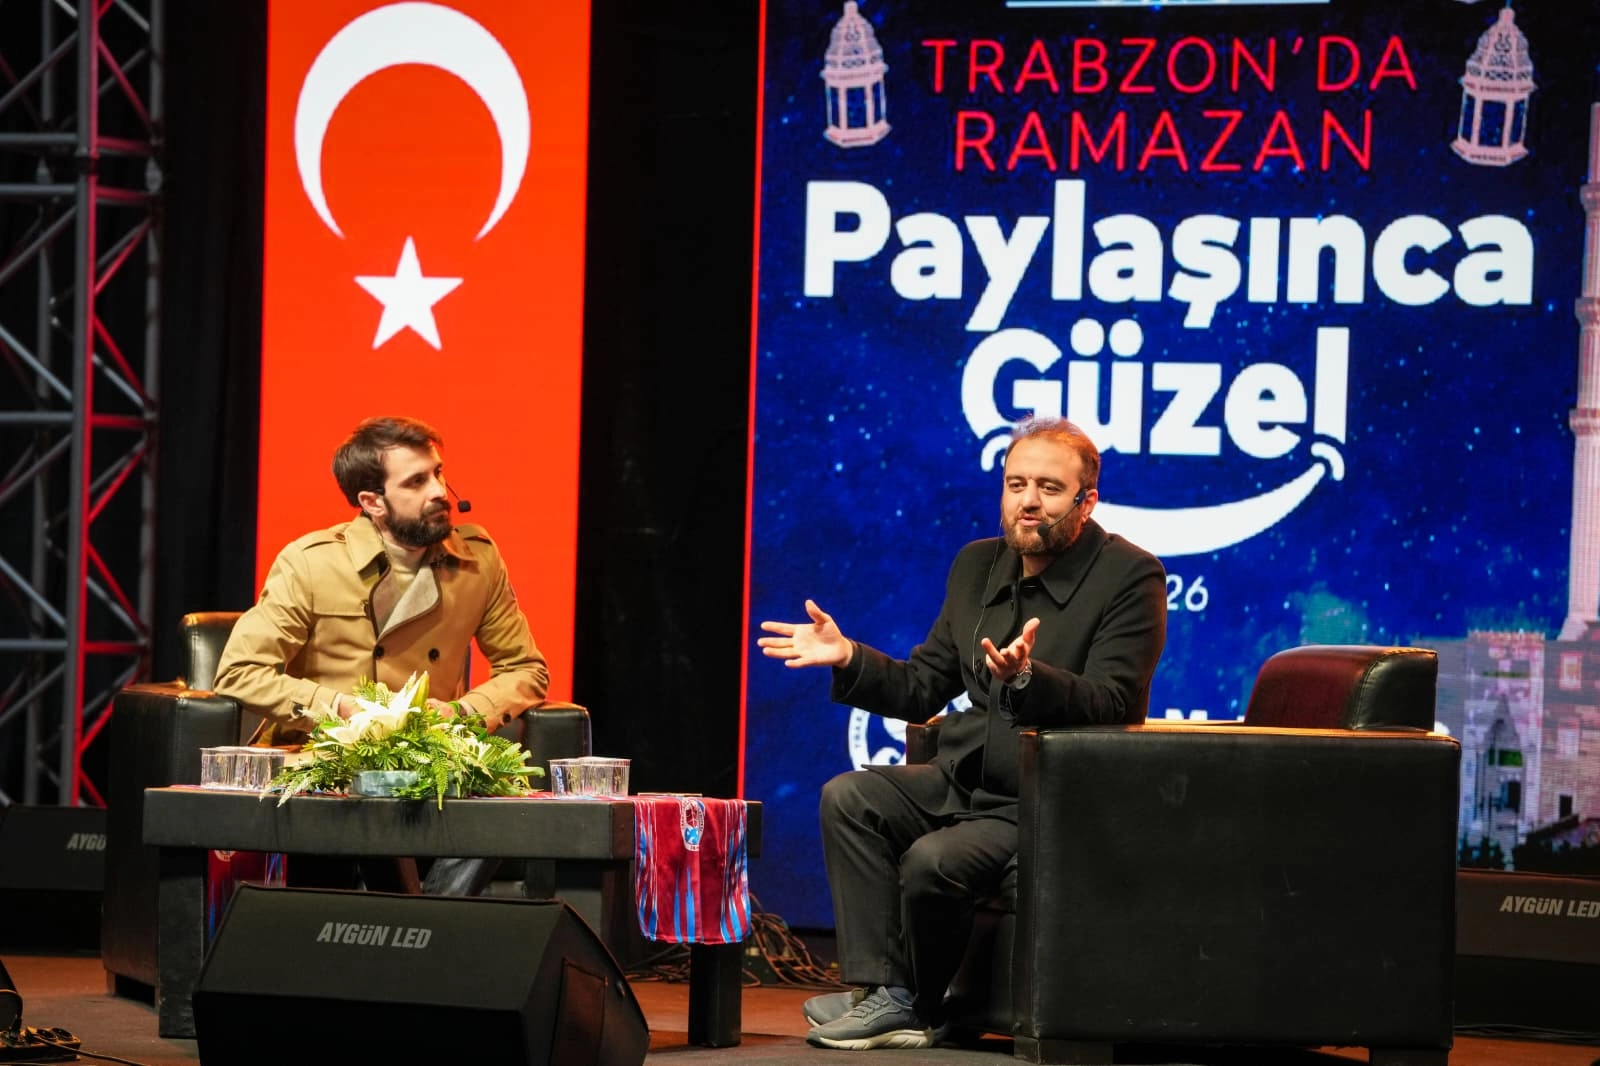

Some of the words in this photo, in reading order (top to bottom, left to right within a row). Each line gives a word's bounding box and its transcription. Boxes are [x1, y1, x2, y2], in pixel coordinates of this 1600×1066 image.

[921, 35, 1417, 94] TRABZON'DA
[954, 109, 1372, 172] RAMAZAN
[803, 179, 1535, 332] Paylaşınca
[961, 318, 1350, 460] Güzel
[66, 832, 106, 850] AYGÜ
[316, 922, 390, 946] AYGÜN
[391, 927, 432, 949] LED
[1500, 895, 1563, 915] AYGÜN
[1566, 900, 1600, 918] LED
